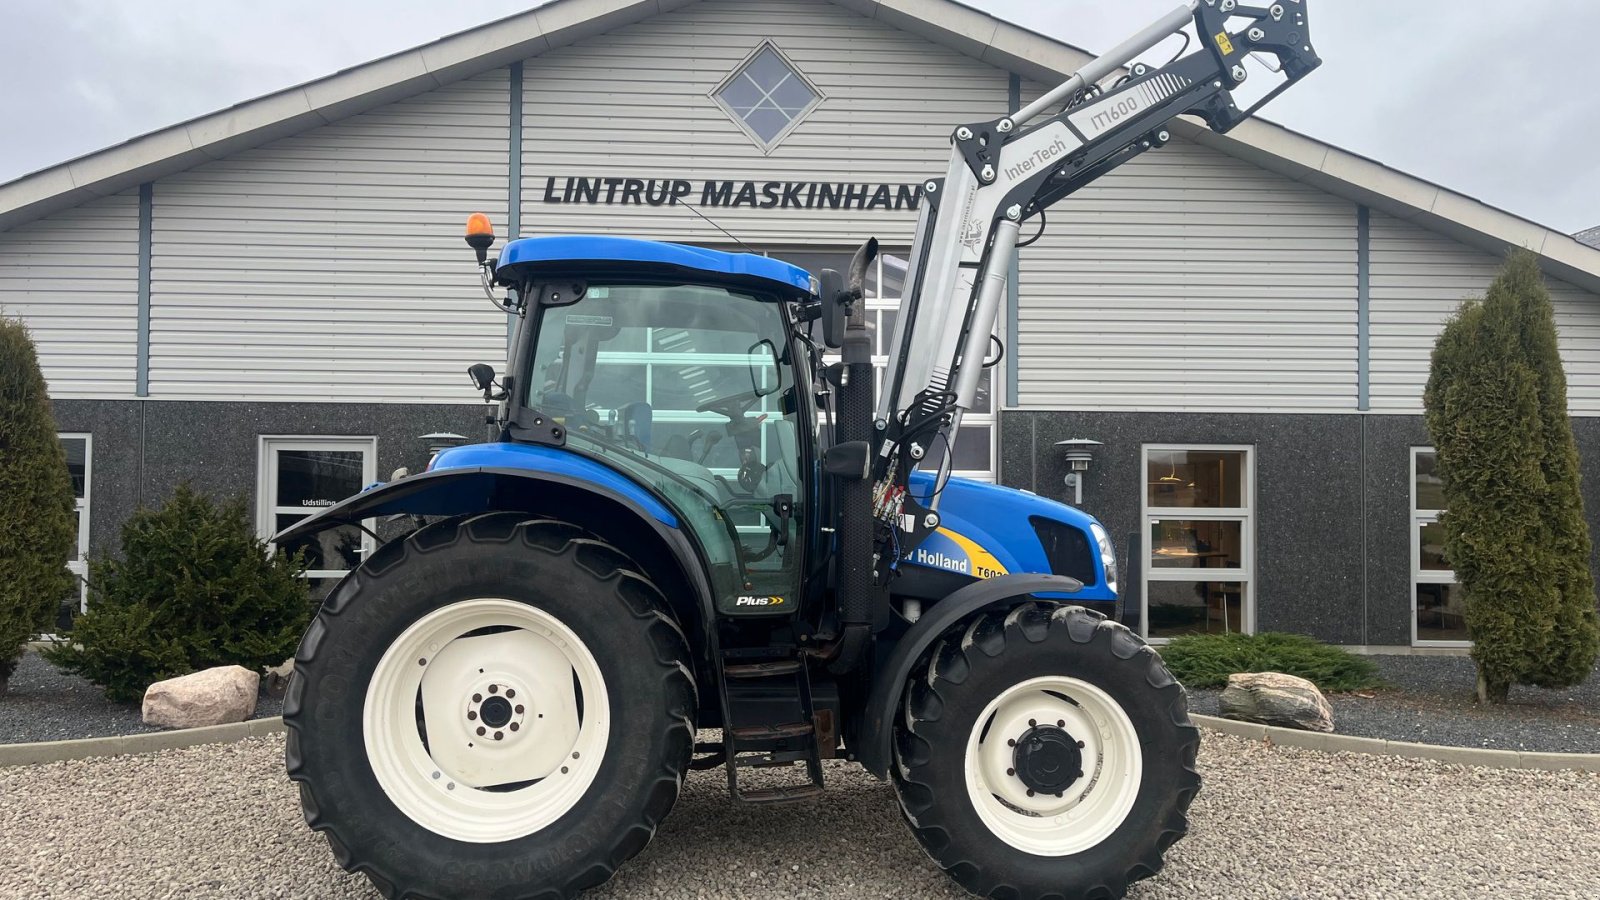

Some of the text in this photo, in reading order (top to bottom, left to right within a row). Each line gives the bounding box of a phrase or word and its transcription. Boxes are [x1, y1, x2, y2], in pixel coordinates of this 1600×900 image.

[1091, 97, 1138, 131] IT1600
[544, 177, 691, 205] LINTRUP
[302, 499, 336, 507] Udstilling
[917, 549, 967, 572] Holland
[977, 566, 1009, 578] T60
[736, 596, 768, 606] Plus
